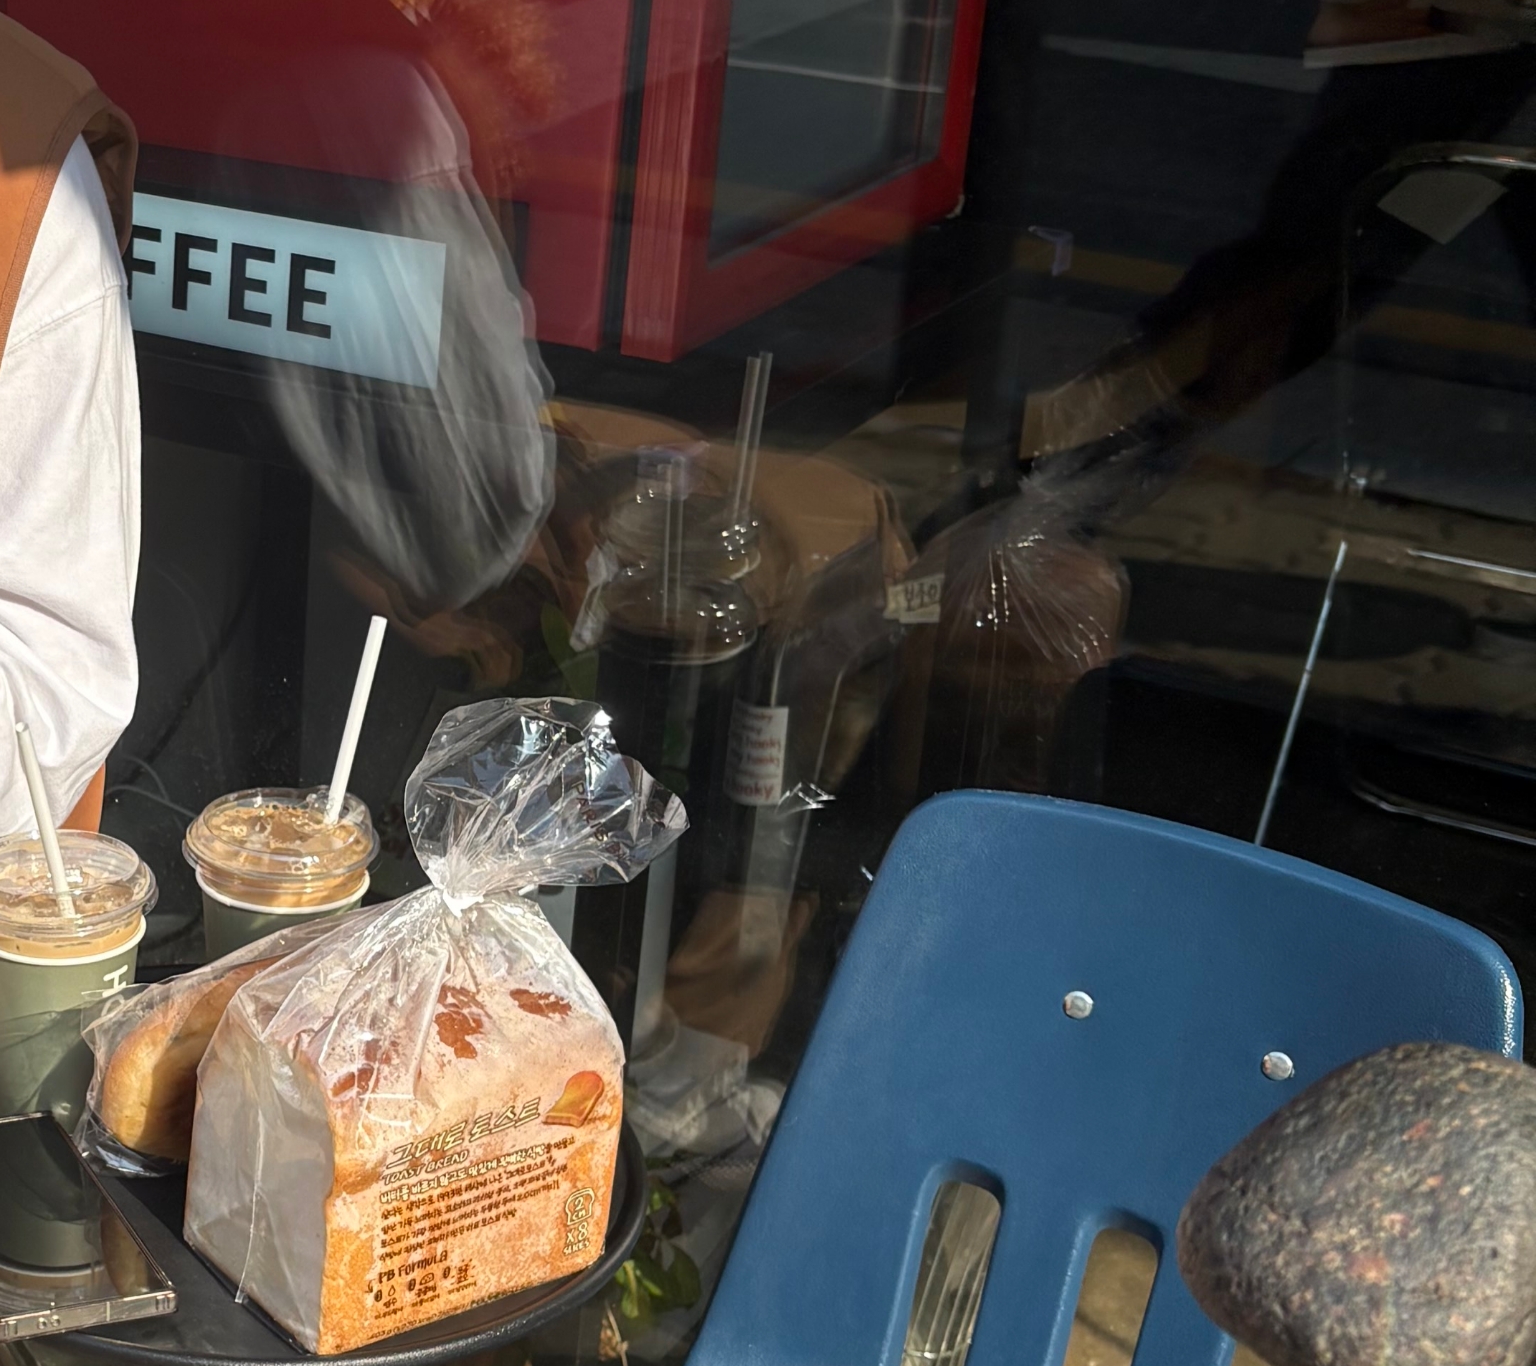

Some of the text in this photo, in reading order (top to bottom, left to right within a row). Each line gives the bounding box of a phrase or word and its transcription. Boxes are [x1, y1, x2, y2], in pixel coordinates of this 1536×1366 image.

[387, 1097, 541, 1169] 그대로 토스트
[380, 1184, 410, 1205] 버터를
[411, 1176, 439, 1196] 바르지
[439, 1166, 468, 1187] 않고도
[468, 1158, 498, 1177] 맛있게
[382, 1149, 470, 1185] TOAST BREAD
[378, 1268, 396, 1285] PB
